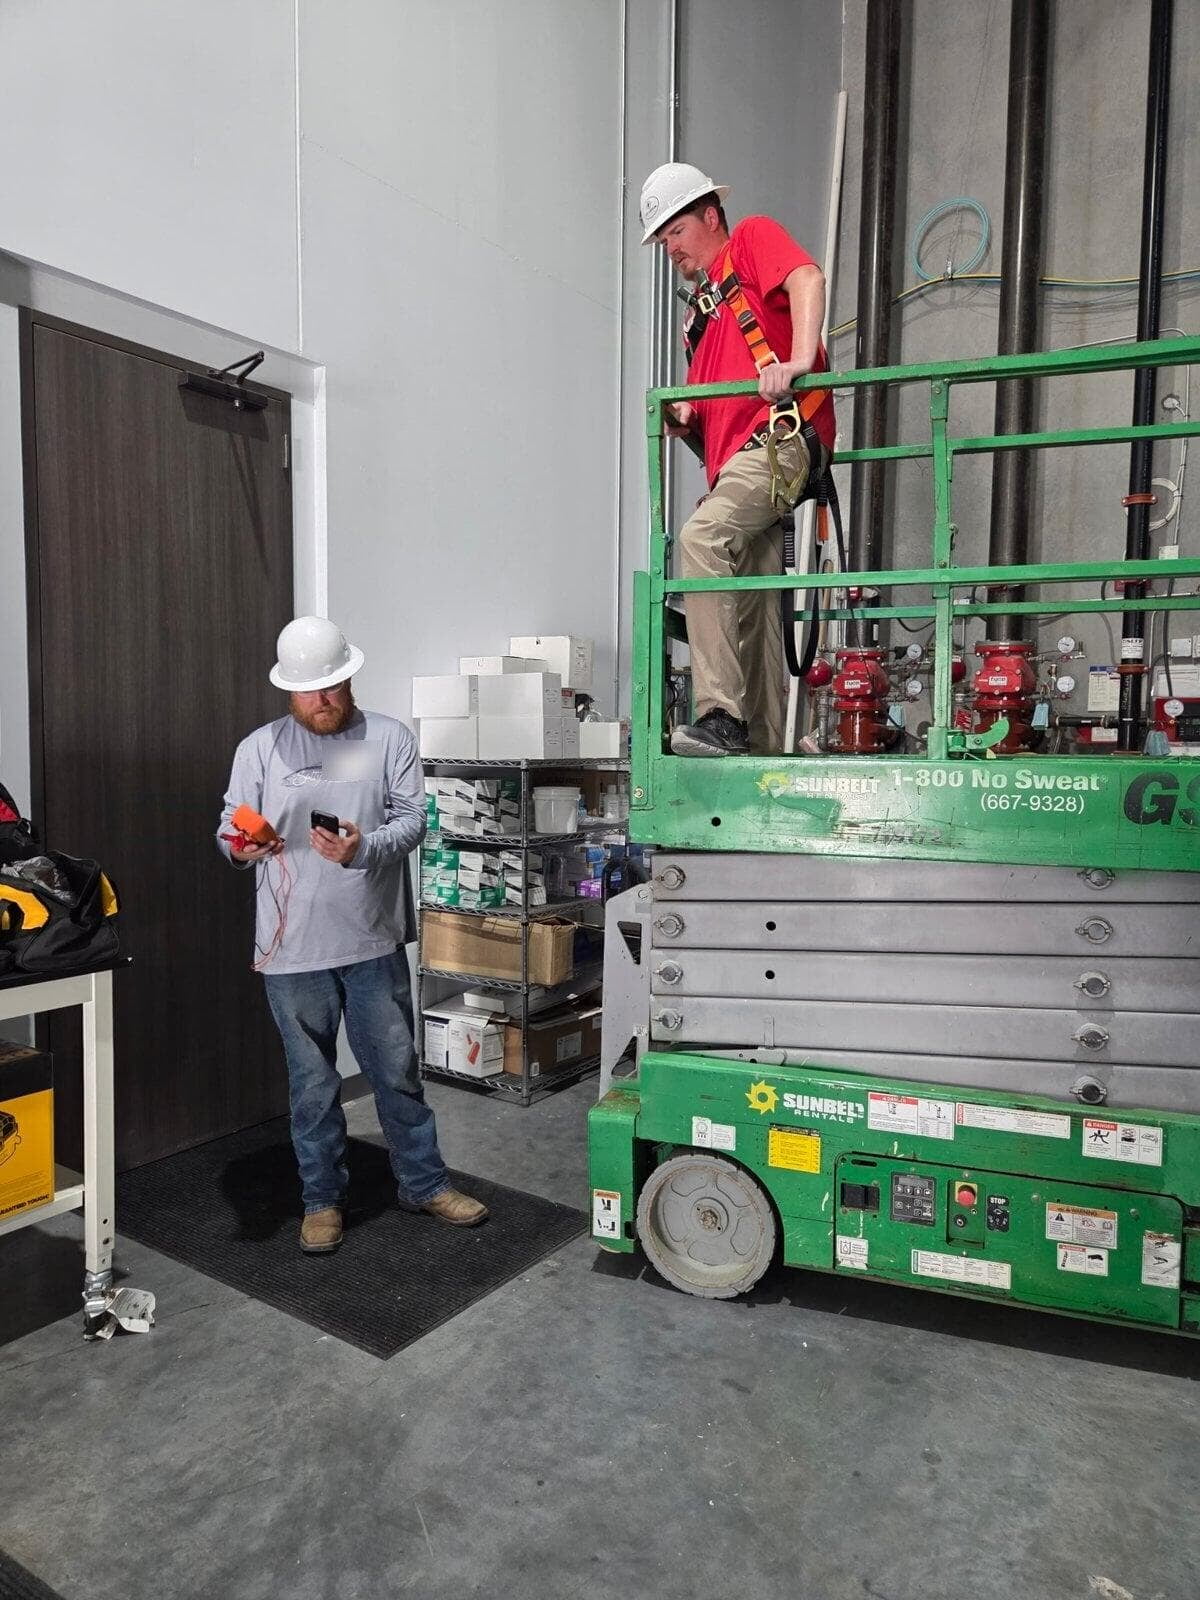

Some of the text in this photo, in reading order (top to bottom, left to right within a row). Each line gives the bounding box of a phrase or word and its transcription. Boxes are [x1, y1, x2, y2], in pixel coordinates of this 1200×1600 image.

[795, 777, 880, 794] SUNBELT
[892, 768, 964, 787] 1-800
[972, 768, 1008, 789] No
[981, 793, 1085, 814] (667-9328)
[1124, 772, 1200, 826] G
[794, 1109, 854, 1124] RENTALS
